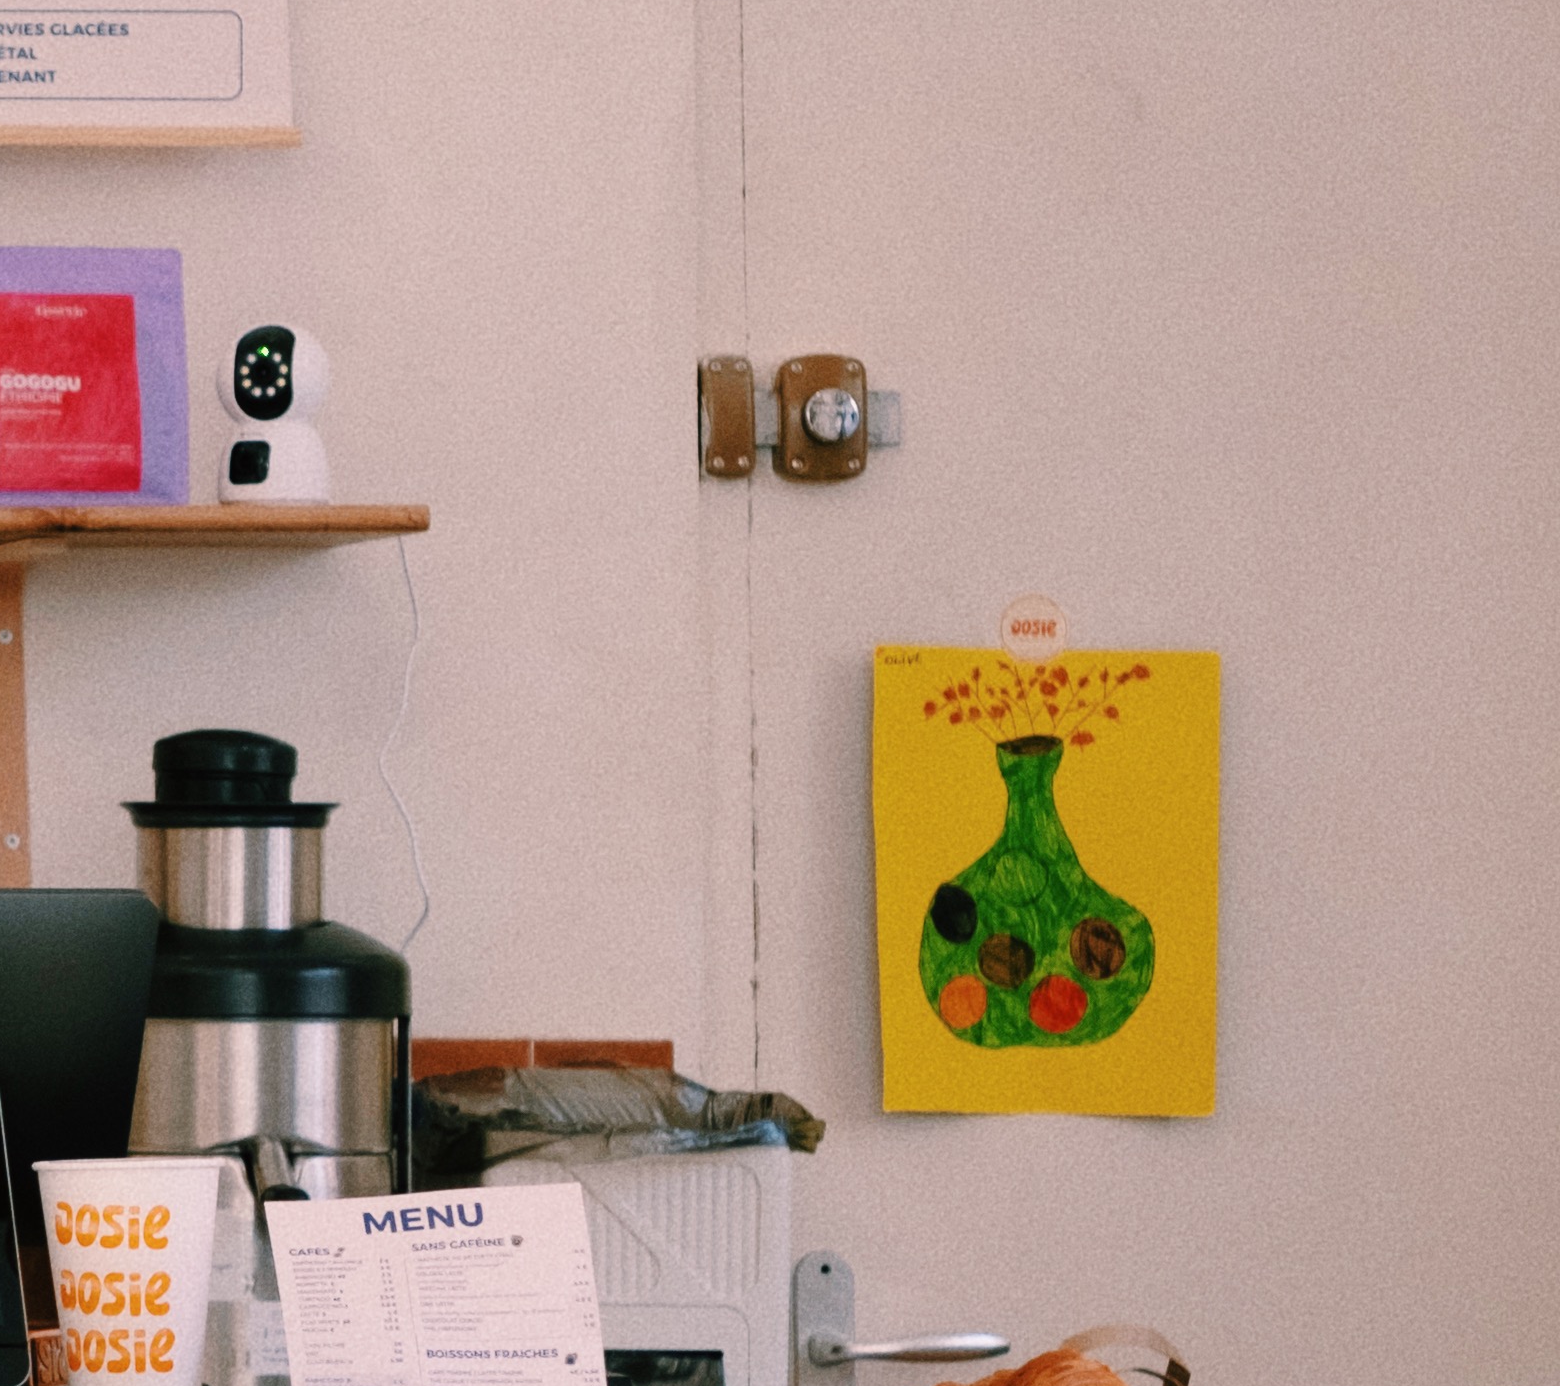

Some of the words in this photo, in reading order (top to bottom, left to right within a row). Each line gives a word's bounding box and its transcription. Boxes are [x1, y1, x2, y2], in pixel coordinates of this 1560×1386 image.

[49, 23, 129, 37] GLACÉES
[362, 1202, 485, 1235] MENU
[411, 1240, 447, 1252] SANS
[426, 1348, 491, 1360] BOISSONS
[494, 1347, 559, 1359] FRAICHES
